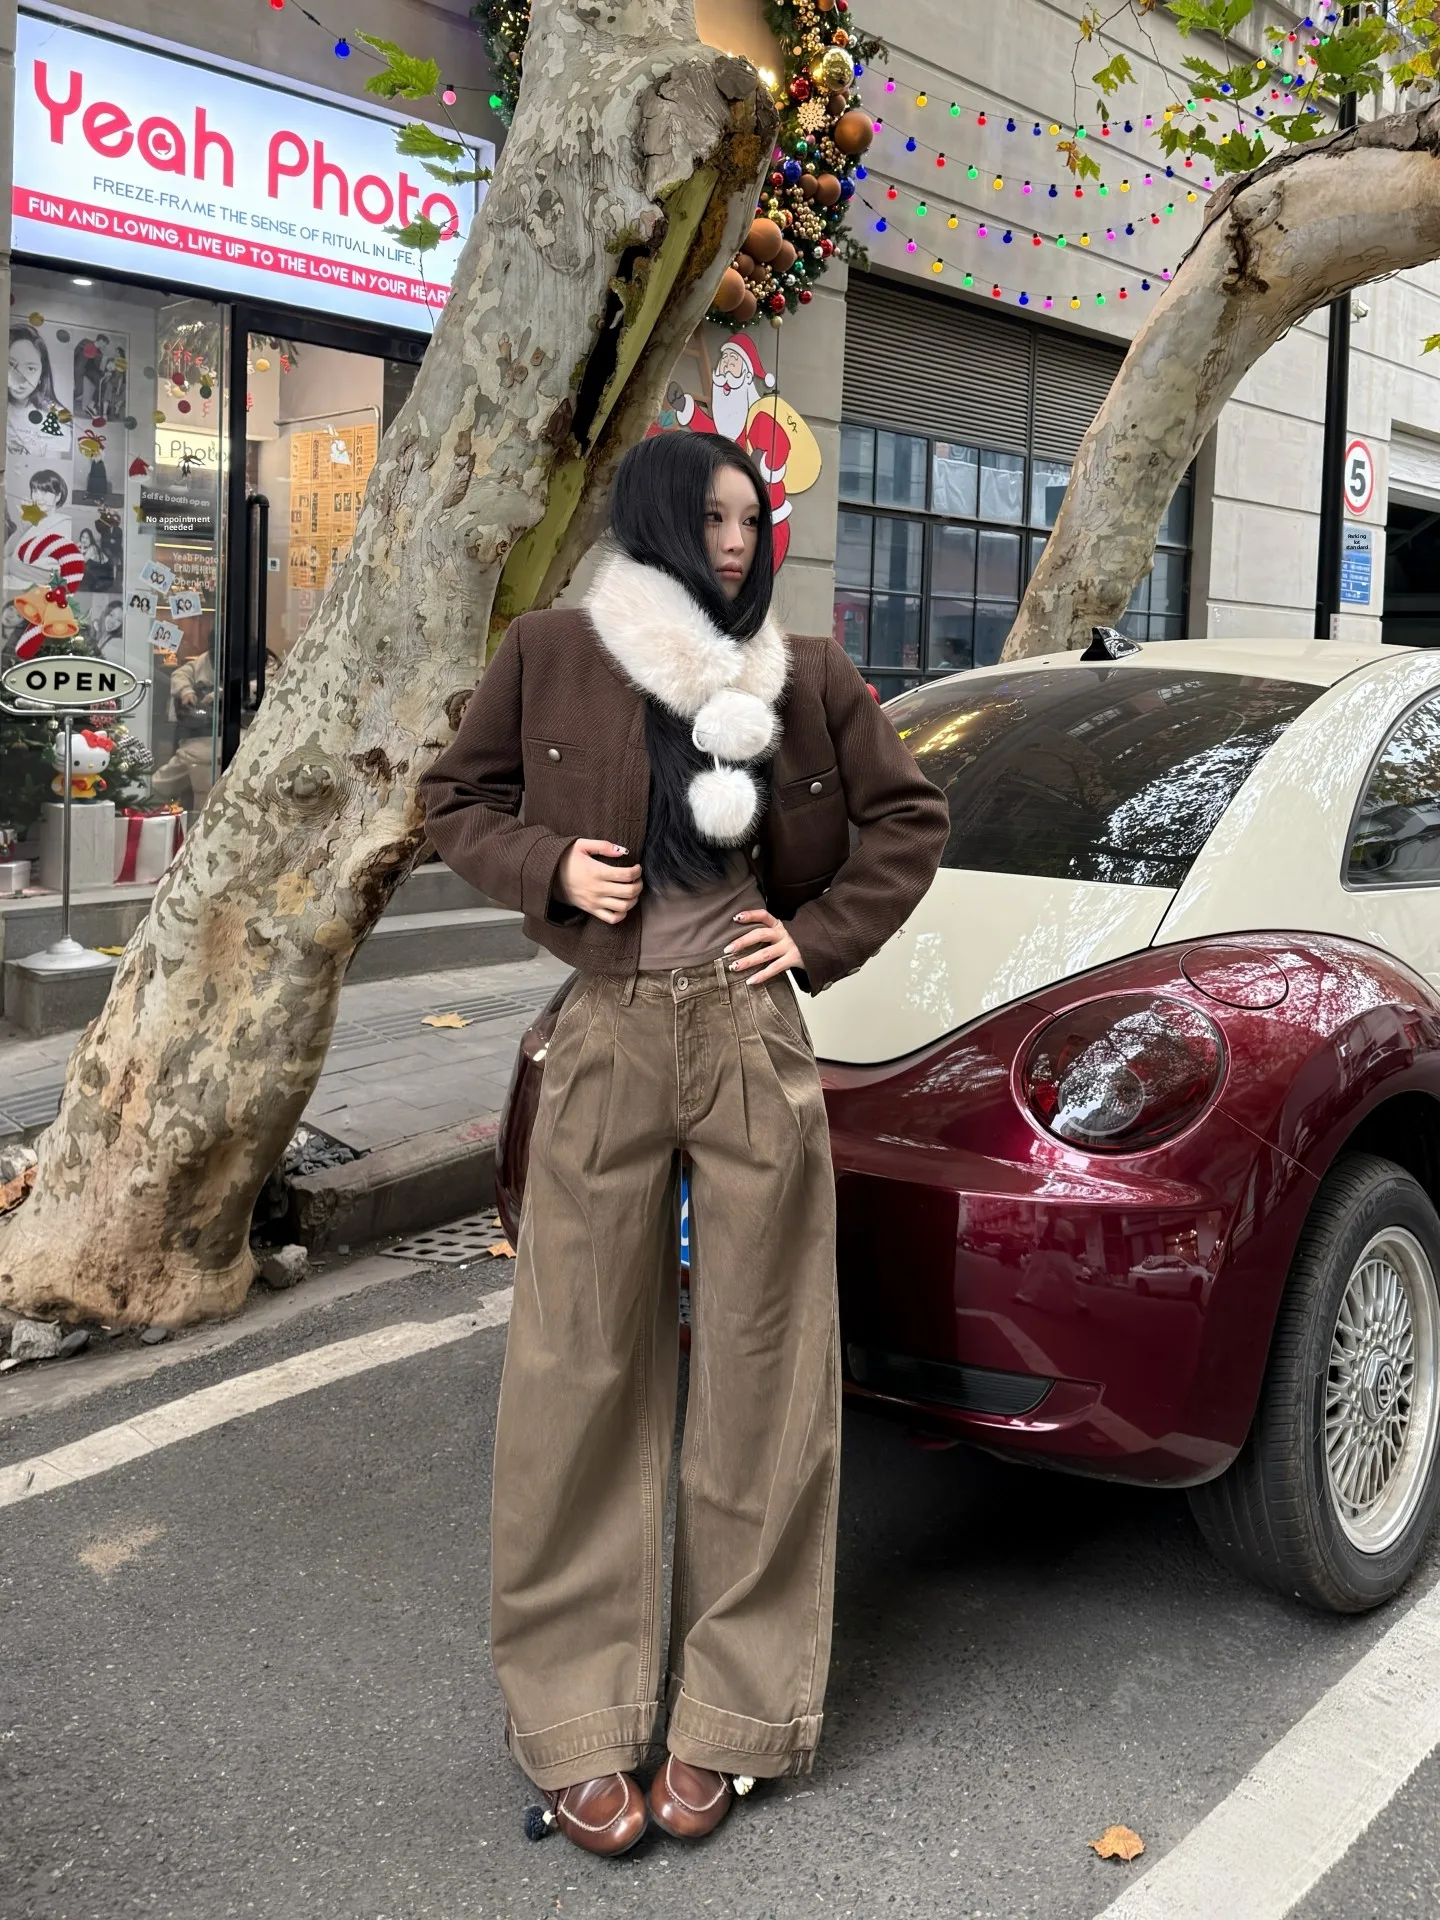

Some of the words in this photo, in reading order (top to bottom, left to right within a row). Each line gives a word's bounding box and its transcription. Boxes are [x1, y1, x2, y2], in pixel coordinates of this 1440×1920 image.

[34, 60, 234, 187] Yeah
[268, 130, 459, 241] Photo
[93, 175, 216, 218] FREEZE-FRAME
[219, 206, 248, 226] THE
[250, 214, 297, 237] SENSE
[300, 226, 320, 242] OF
[322, 231, 370, 255] RITUAL
[373, 243, 386, 259] IN
[387, 247, 416, 266] LIFE.
[28, 196, 64, 220] FUN
[68, 207, 110, 229] AND
[113, 216, 184, 249] LOVING,
[188, 233, 222, 255] LIVE
[225, 241, 246, 259] UP
[250, 247, 274, 266] TO
[277, 253, 307, 273] THE
[309, 260, 349, 284] LOVE
[351, 269, 366, 287] IN
[369, 273, 407, 297] YOUR
[410, 283, 451, 305] HEAR
[1350, 458, 1366, 498] 5
[145, 515, 158, 523] No
[158, 515, 211, 524] appointment
[164, 523, 194, 531] needed
[26, 670, 116, 692] OPEN
